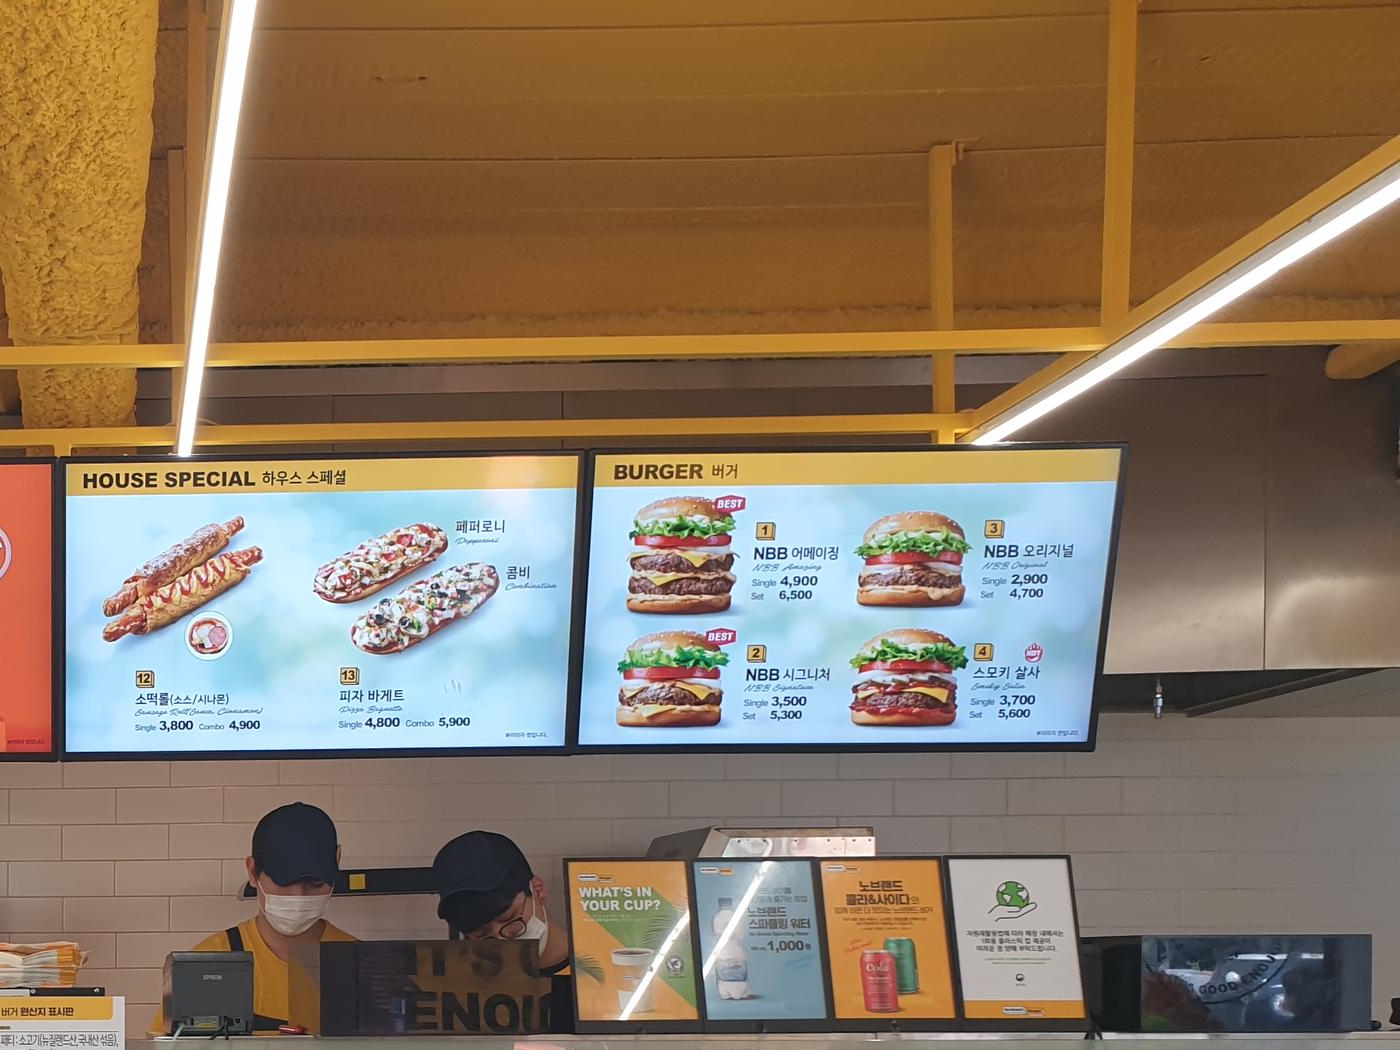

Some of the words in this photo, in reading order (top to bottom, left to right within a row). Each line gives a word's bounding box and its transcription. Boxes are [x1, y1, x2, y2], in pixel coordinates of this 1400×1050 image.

[82, 471, 158, 490] HOUSE
[164, 469, 256, 489] SPECIAL
[262, 469, 302, 487] 하우스
[306, 468, 348, 486] 스페셜
[613, 463, 704, 481] BURGER
[711, 463, 739, 480] 버거
[716, 497, 743, 511] BEST
[455, 520, 506, 535] 페퍼로니
[761, 524, 769, 537] 1
[989, 522, 999, 535] 3
[753, 547, 788, 561] NBB
[791, 545, 840, 561] 어메이징
[983, 544, 1019, 559] NBB
[1022, 542, 1074, 559] 오리지널
[506, 565, 531, 580] 콤비
[751, 577, 776, 589] Single
[780, 575, 818, 589] 4,900
[981, 575, 1007, 587] Single
[1010, 573, 1048, 587] 2,900
[751, 590, 764, 601] Set
[778, 588, 813, 602] 6,500
[980, 588, 993, 599] Set
[1009, 587, 1044, 600] 4,700
[707, 630, 734, 643] BEST
[752, 647, 760, 659] 2
[978, 645, 988, 658] 4
[137, 672, 151, 686] 12
[341, 669, 356, 683] 13
[745, 667, 780, 682] NBB
[782, 666, 831, 682] 시그니처
[973, 665, 1011, 681] 스모키
[1015, 665, 1041, 681] 살사
[339, 688, 364, 704] 피자
[366, 688, 405, 703] 바게트
[743, 698, 769, 709] Single
[770, 695, 808, 709] 3,500
[970, 697, 996, 708] Single
[999, 694, 1036, 708] 3,700
[742, 712, 756, 721] Set
[769, 709, 803, 722] 5,300
[969, 710, 983, 719] Set
[998, 708, 1031, 721] 5,600
[135, 722, 157, 733] Single
[159, 720, 194, 733] 3,800
[198, 723, 225, 731] Combo
[229, 719, 261, 732] 4,900
[338, 719, 363, 730] Single
[365, 716, 401, 730] 4,800
[405, 719, 435, 729] Combo
[438, 716, 471, 729] 5,900
[579, 886, 633, 898] WHAT'S
[637, 886, 652, 897] IN
[859, 880, 904, 892] 노브랜드
[580, 900, 620, 911] YOUR
[624, 899, 661, 911] CUP?
[2, 1007, 18, 1017] 버거
[20, 1007, 46, 1017] 원산지
[48, 1007, 74, 1017] 표시판
